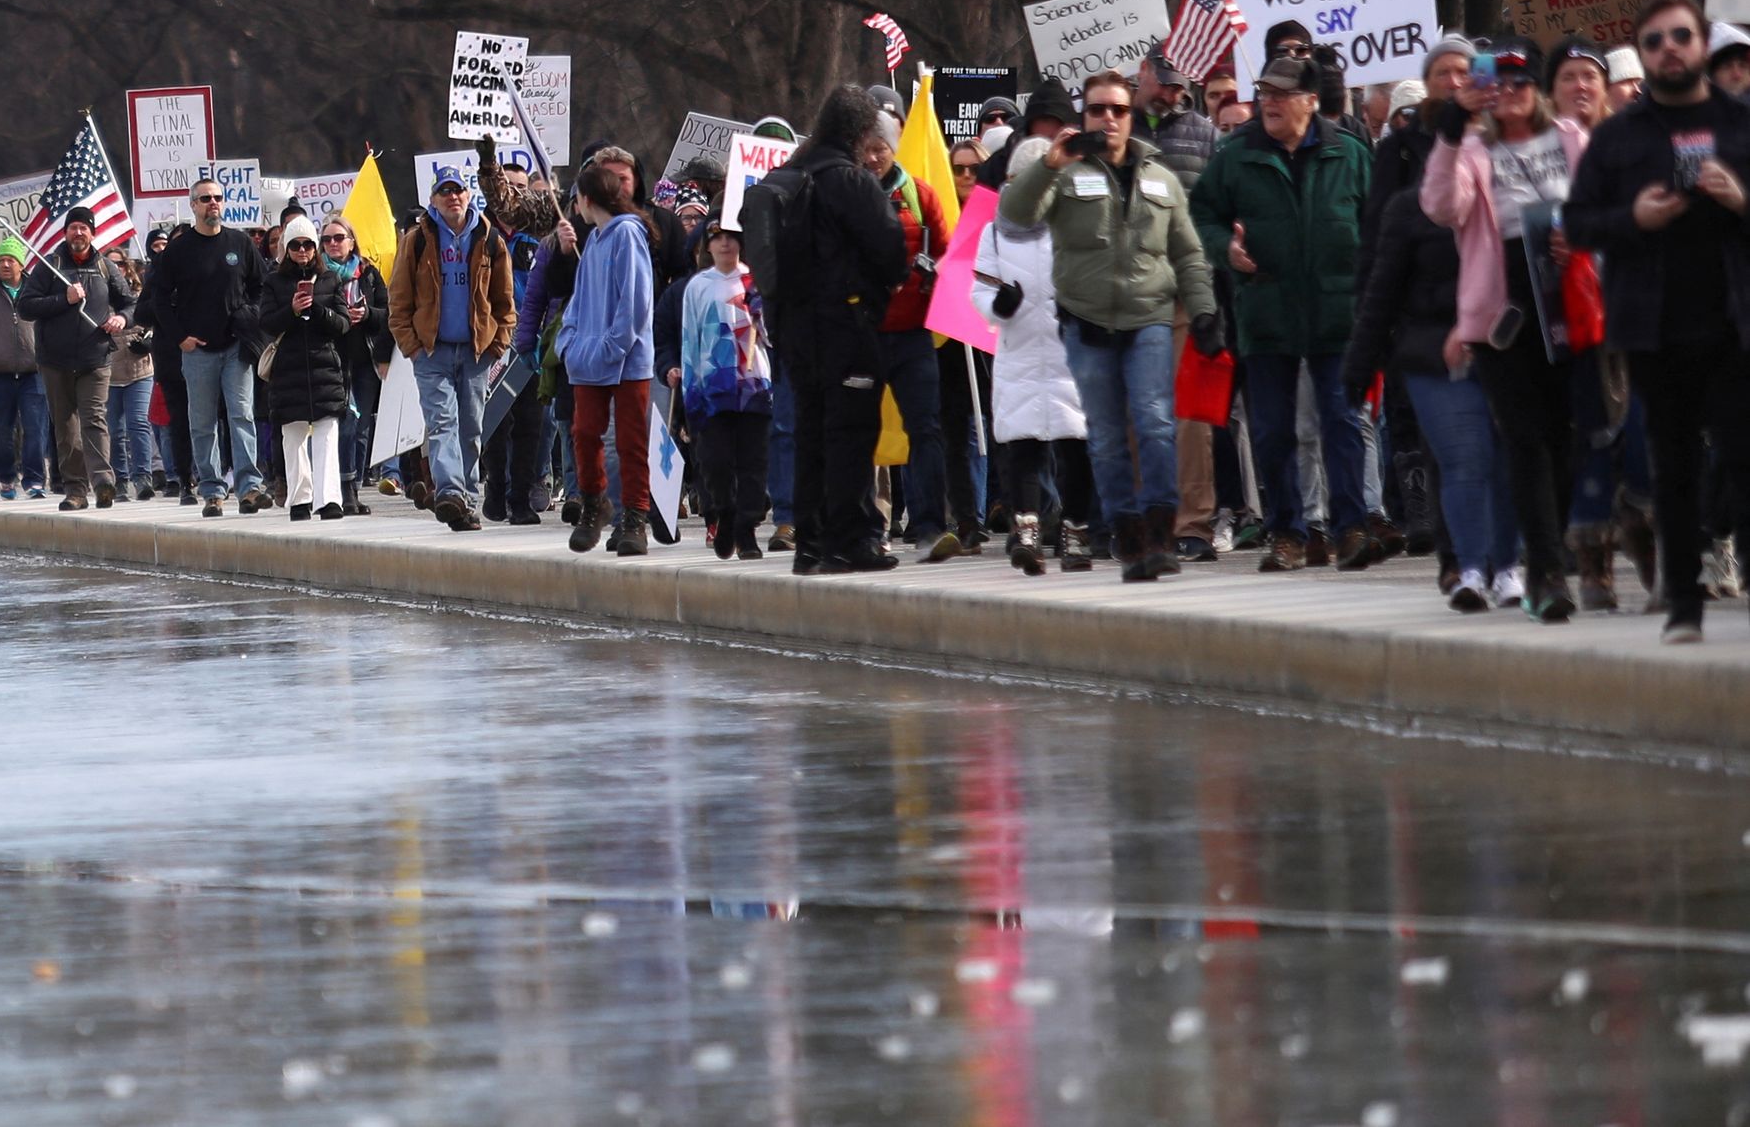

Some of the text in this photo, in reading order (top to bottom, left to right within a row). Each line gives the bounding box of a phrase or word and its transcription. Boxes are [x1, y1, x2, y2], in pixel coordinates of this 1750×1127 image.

[1033, 0, 1098, 26] Science
[1316, 5, 1358, 35] SAY
[1059, 12, 1139, 51] debate is
[481, 39, 502, 55] NO
[1351, 22, 1428, 67] OVER
[941, 67, 964, 75] DEFEAT
[453, 74, 523, 92] VACCINS
[157, 96, 183, 111] THE
[476, 92, 493, 107] IN
[152, 113, 196, 133] FINAL
[944, 119, 978, 135] TREAT
[139, 133, 194, 148] VARIANT
[168, 151, 181, 162] IS
[198, 163, 256, 185] FIGHT
[222, 206, 260, 223] ANNY
[304, 200, 334, 216] TO
